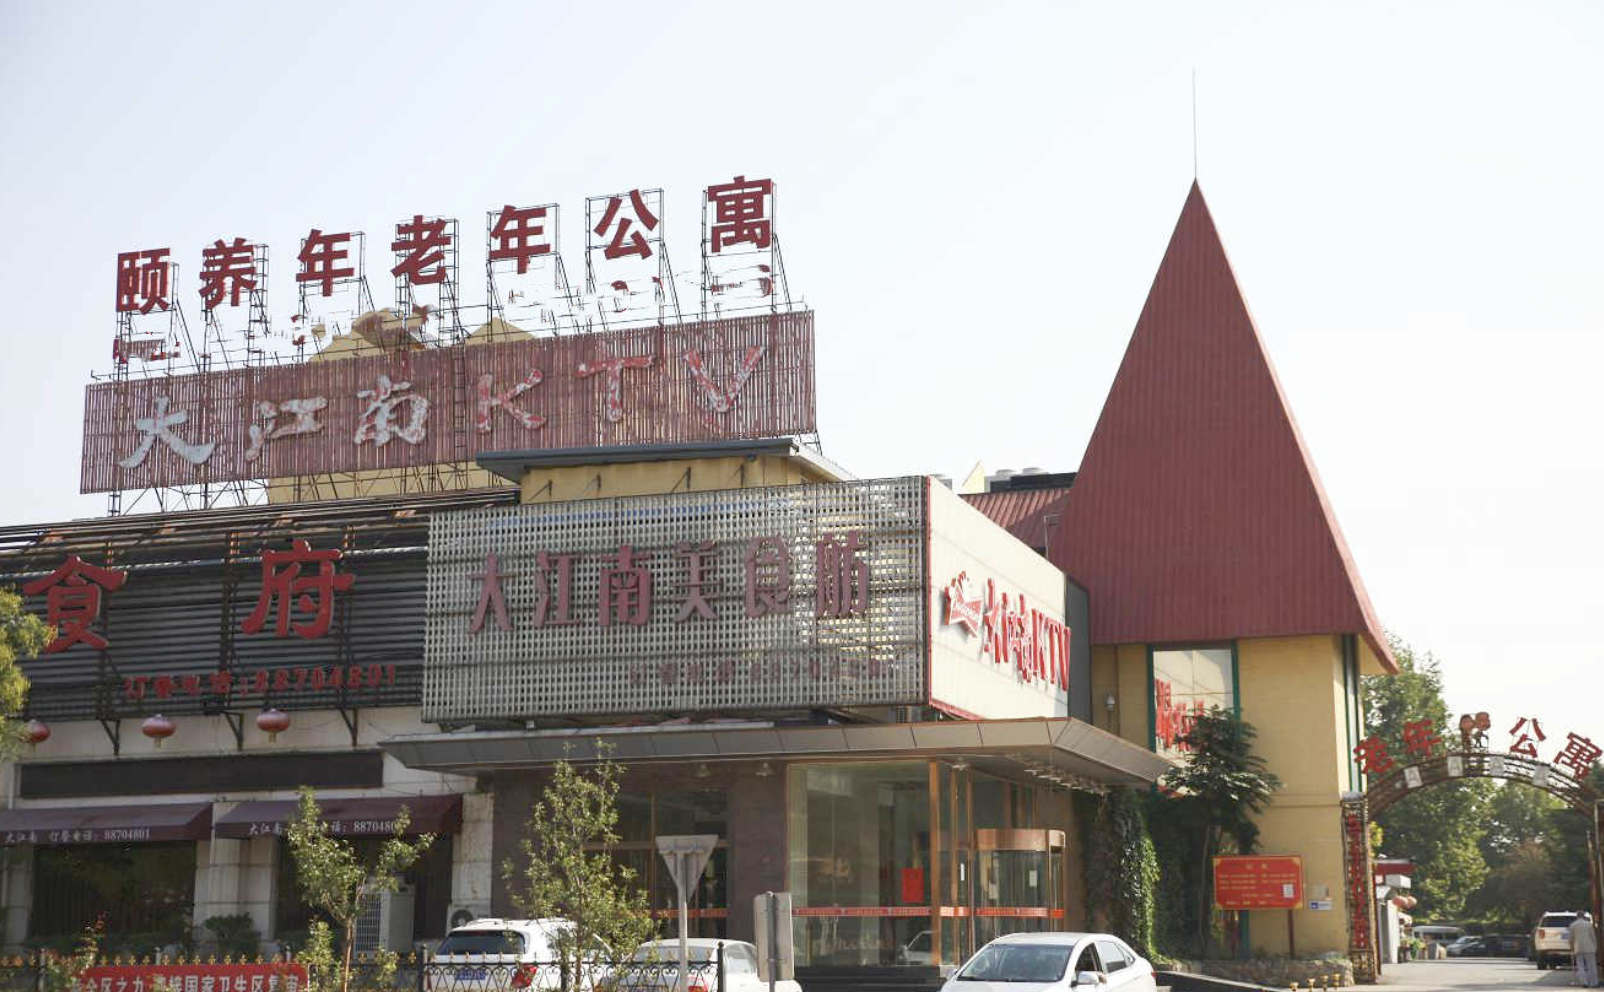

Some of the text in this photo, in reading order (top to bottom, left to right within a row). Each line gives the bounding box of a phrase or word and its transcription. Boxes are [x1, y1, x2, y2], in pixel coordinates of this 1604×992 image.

[116, 175, 773, 315] 颐养年老年公寓
[23, 538, 357, 653] 食府
